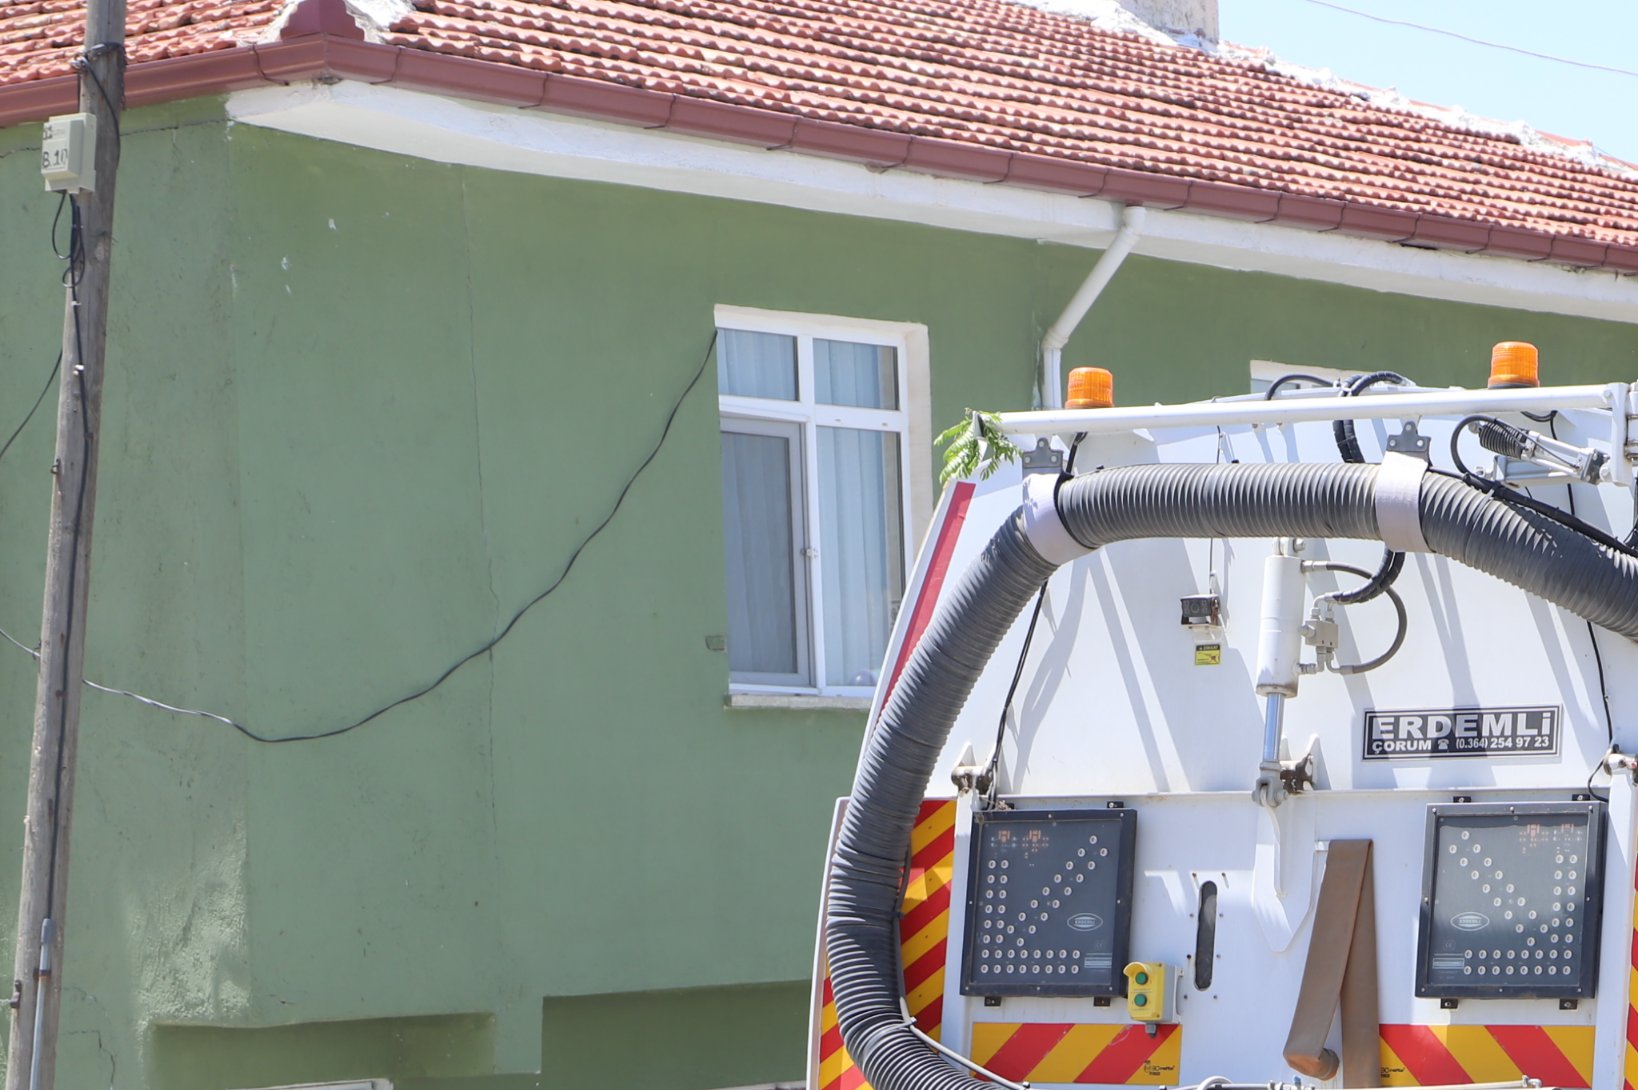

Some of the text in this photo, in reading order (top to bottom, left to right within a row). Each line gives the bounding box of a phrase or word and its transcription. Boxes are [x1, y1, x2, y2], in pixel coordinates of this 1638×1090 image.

[1372, 736, 1550, 755] ÇORUM (0.364) 254 97 23
